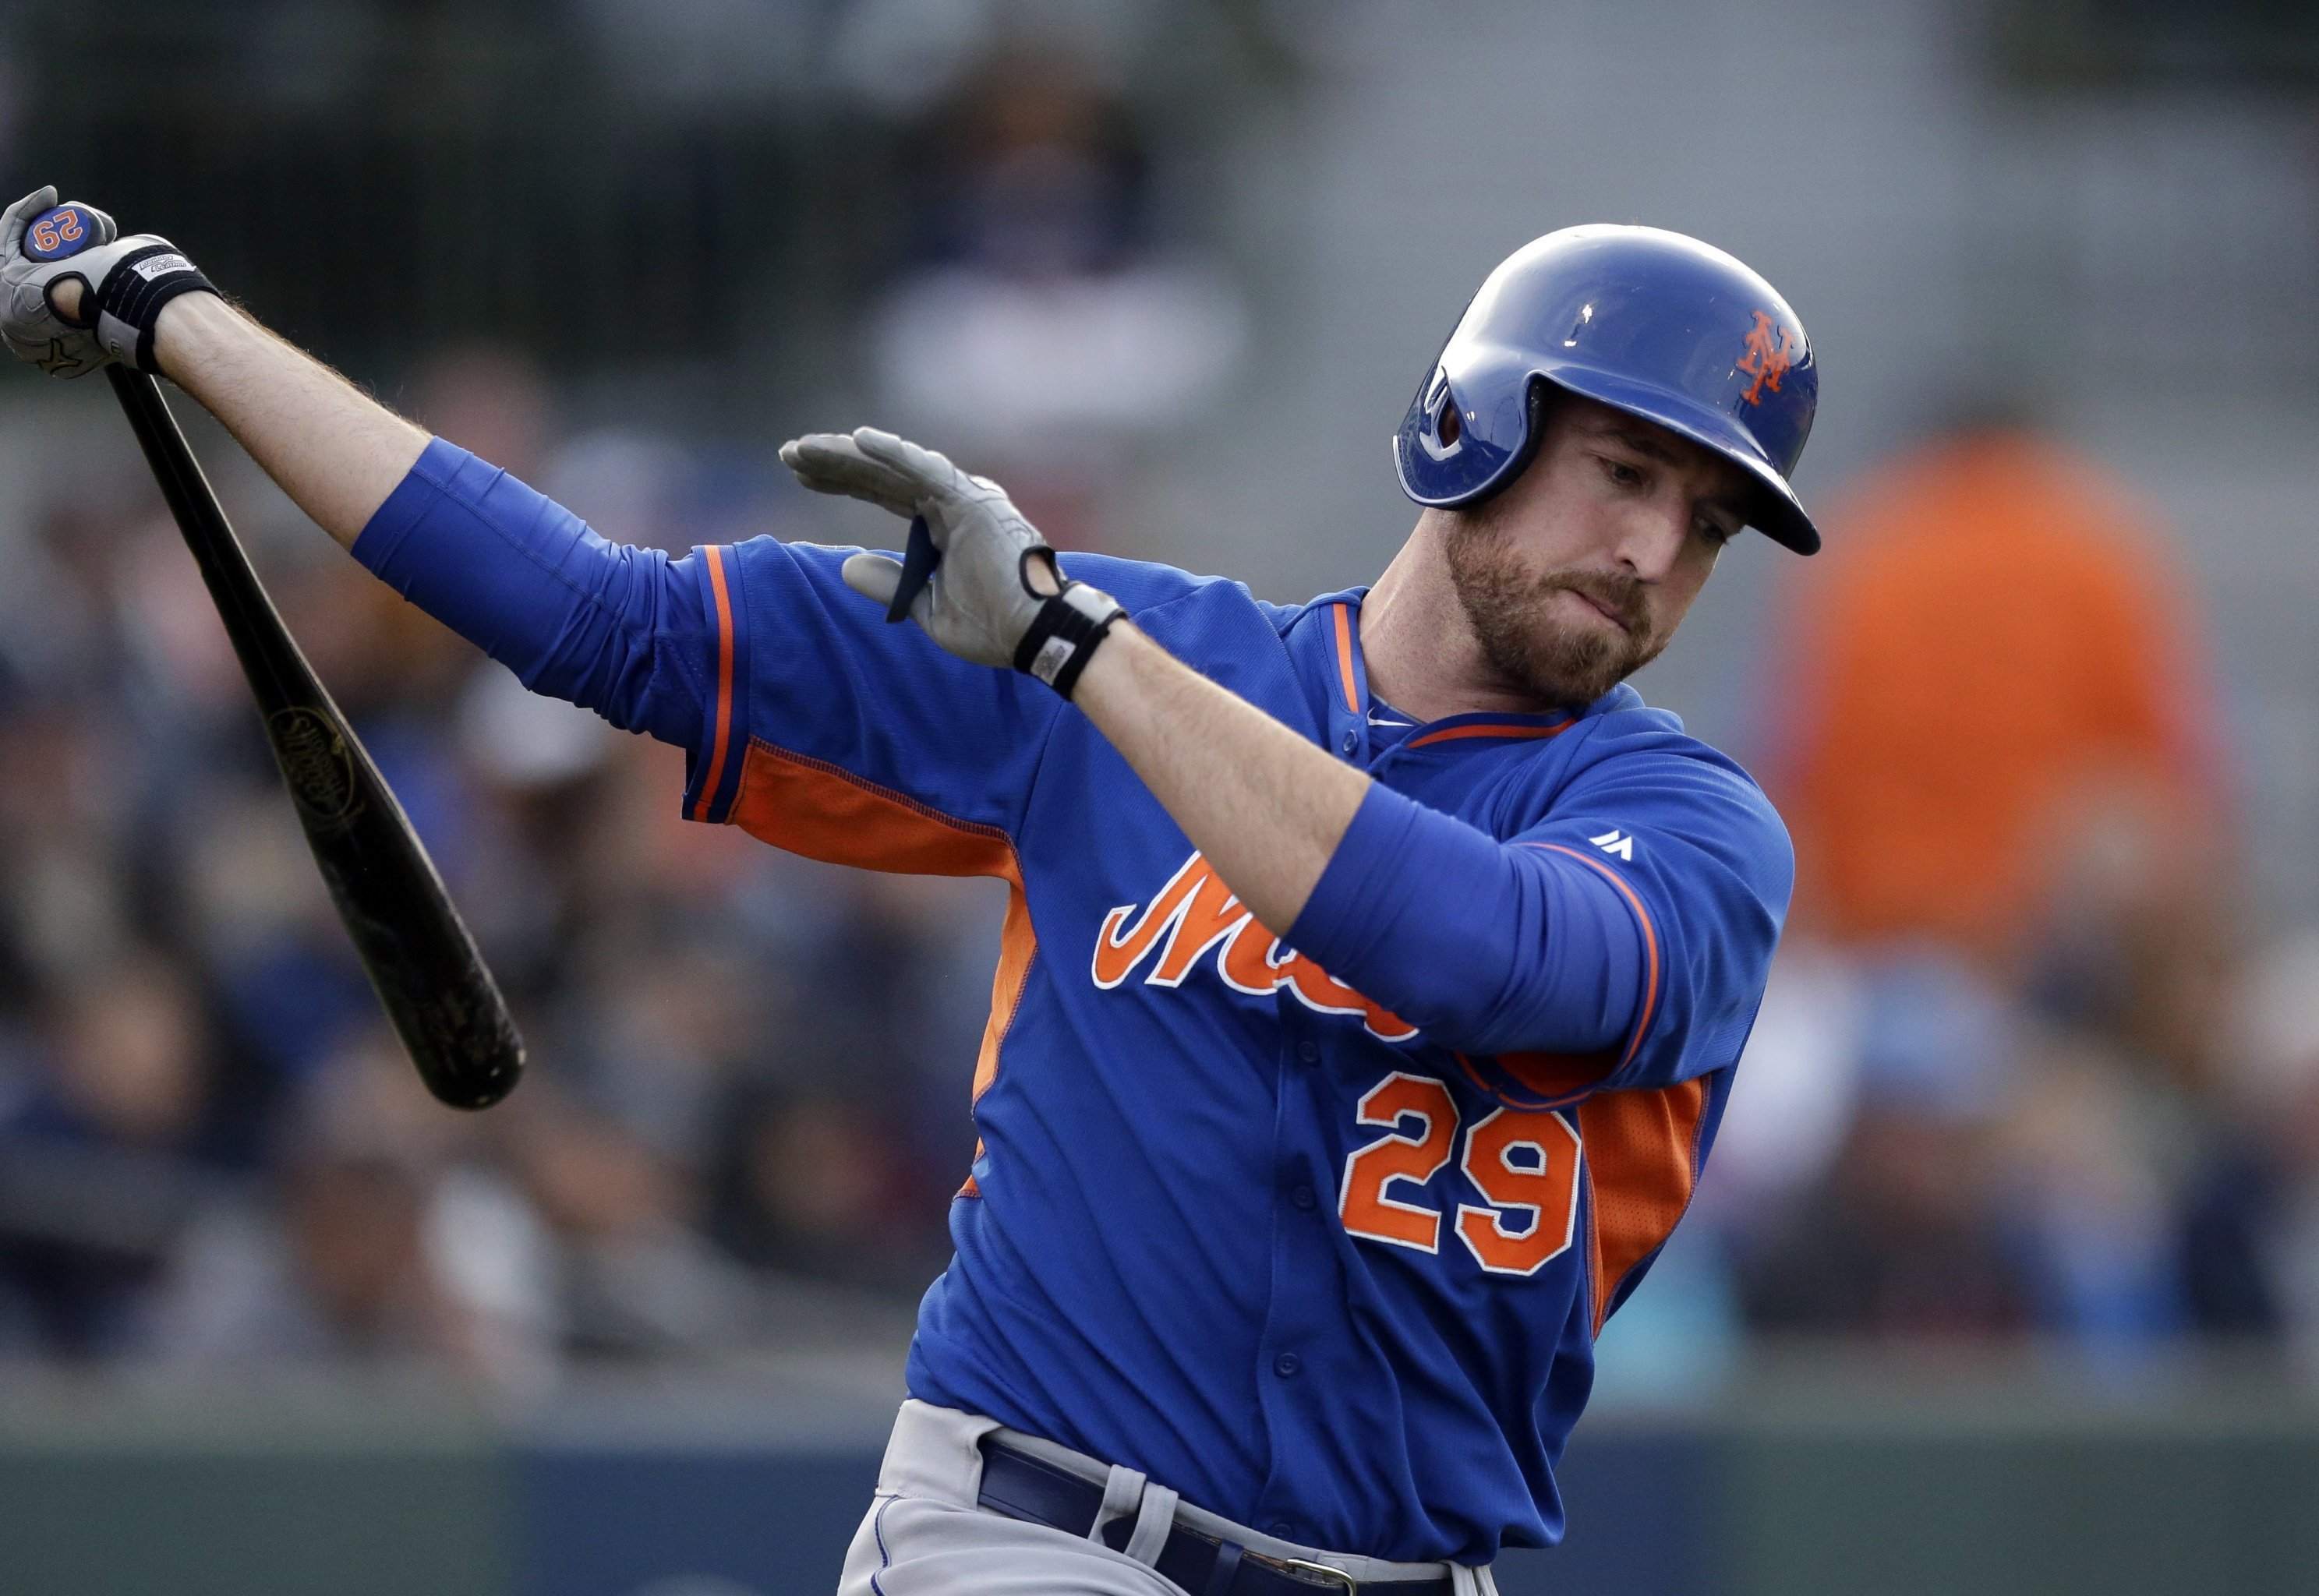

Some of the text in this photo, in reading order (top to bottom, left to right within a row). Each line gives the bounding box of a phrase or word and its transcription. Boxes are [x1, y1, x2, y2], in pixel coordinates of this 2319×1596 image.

[33, 208, 83, 252] 29
[1736, 309, 1796, 407] NY
[1338, 1070, 1582, 1277] 29
